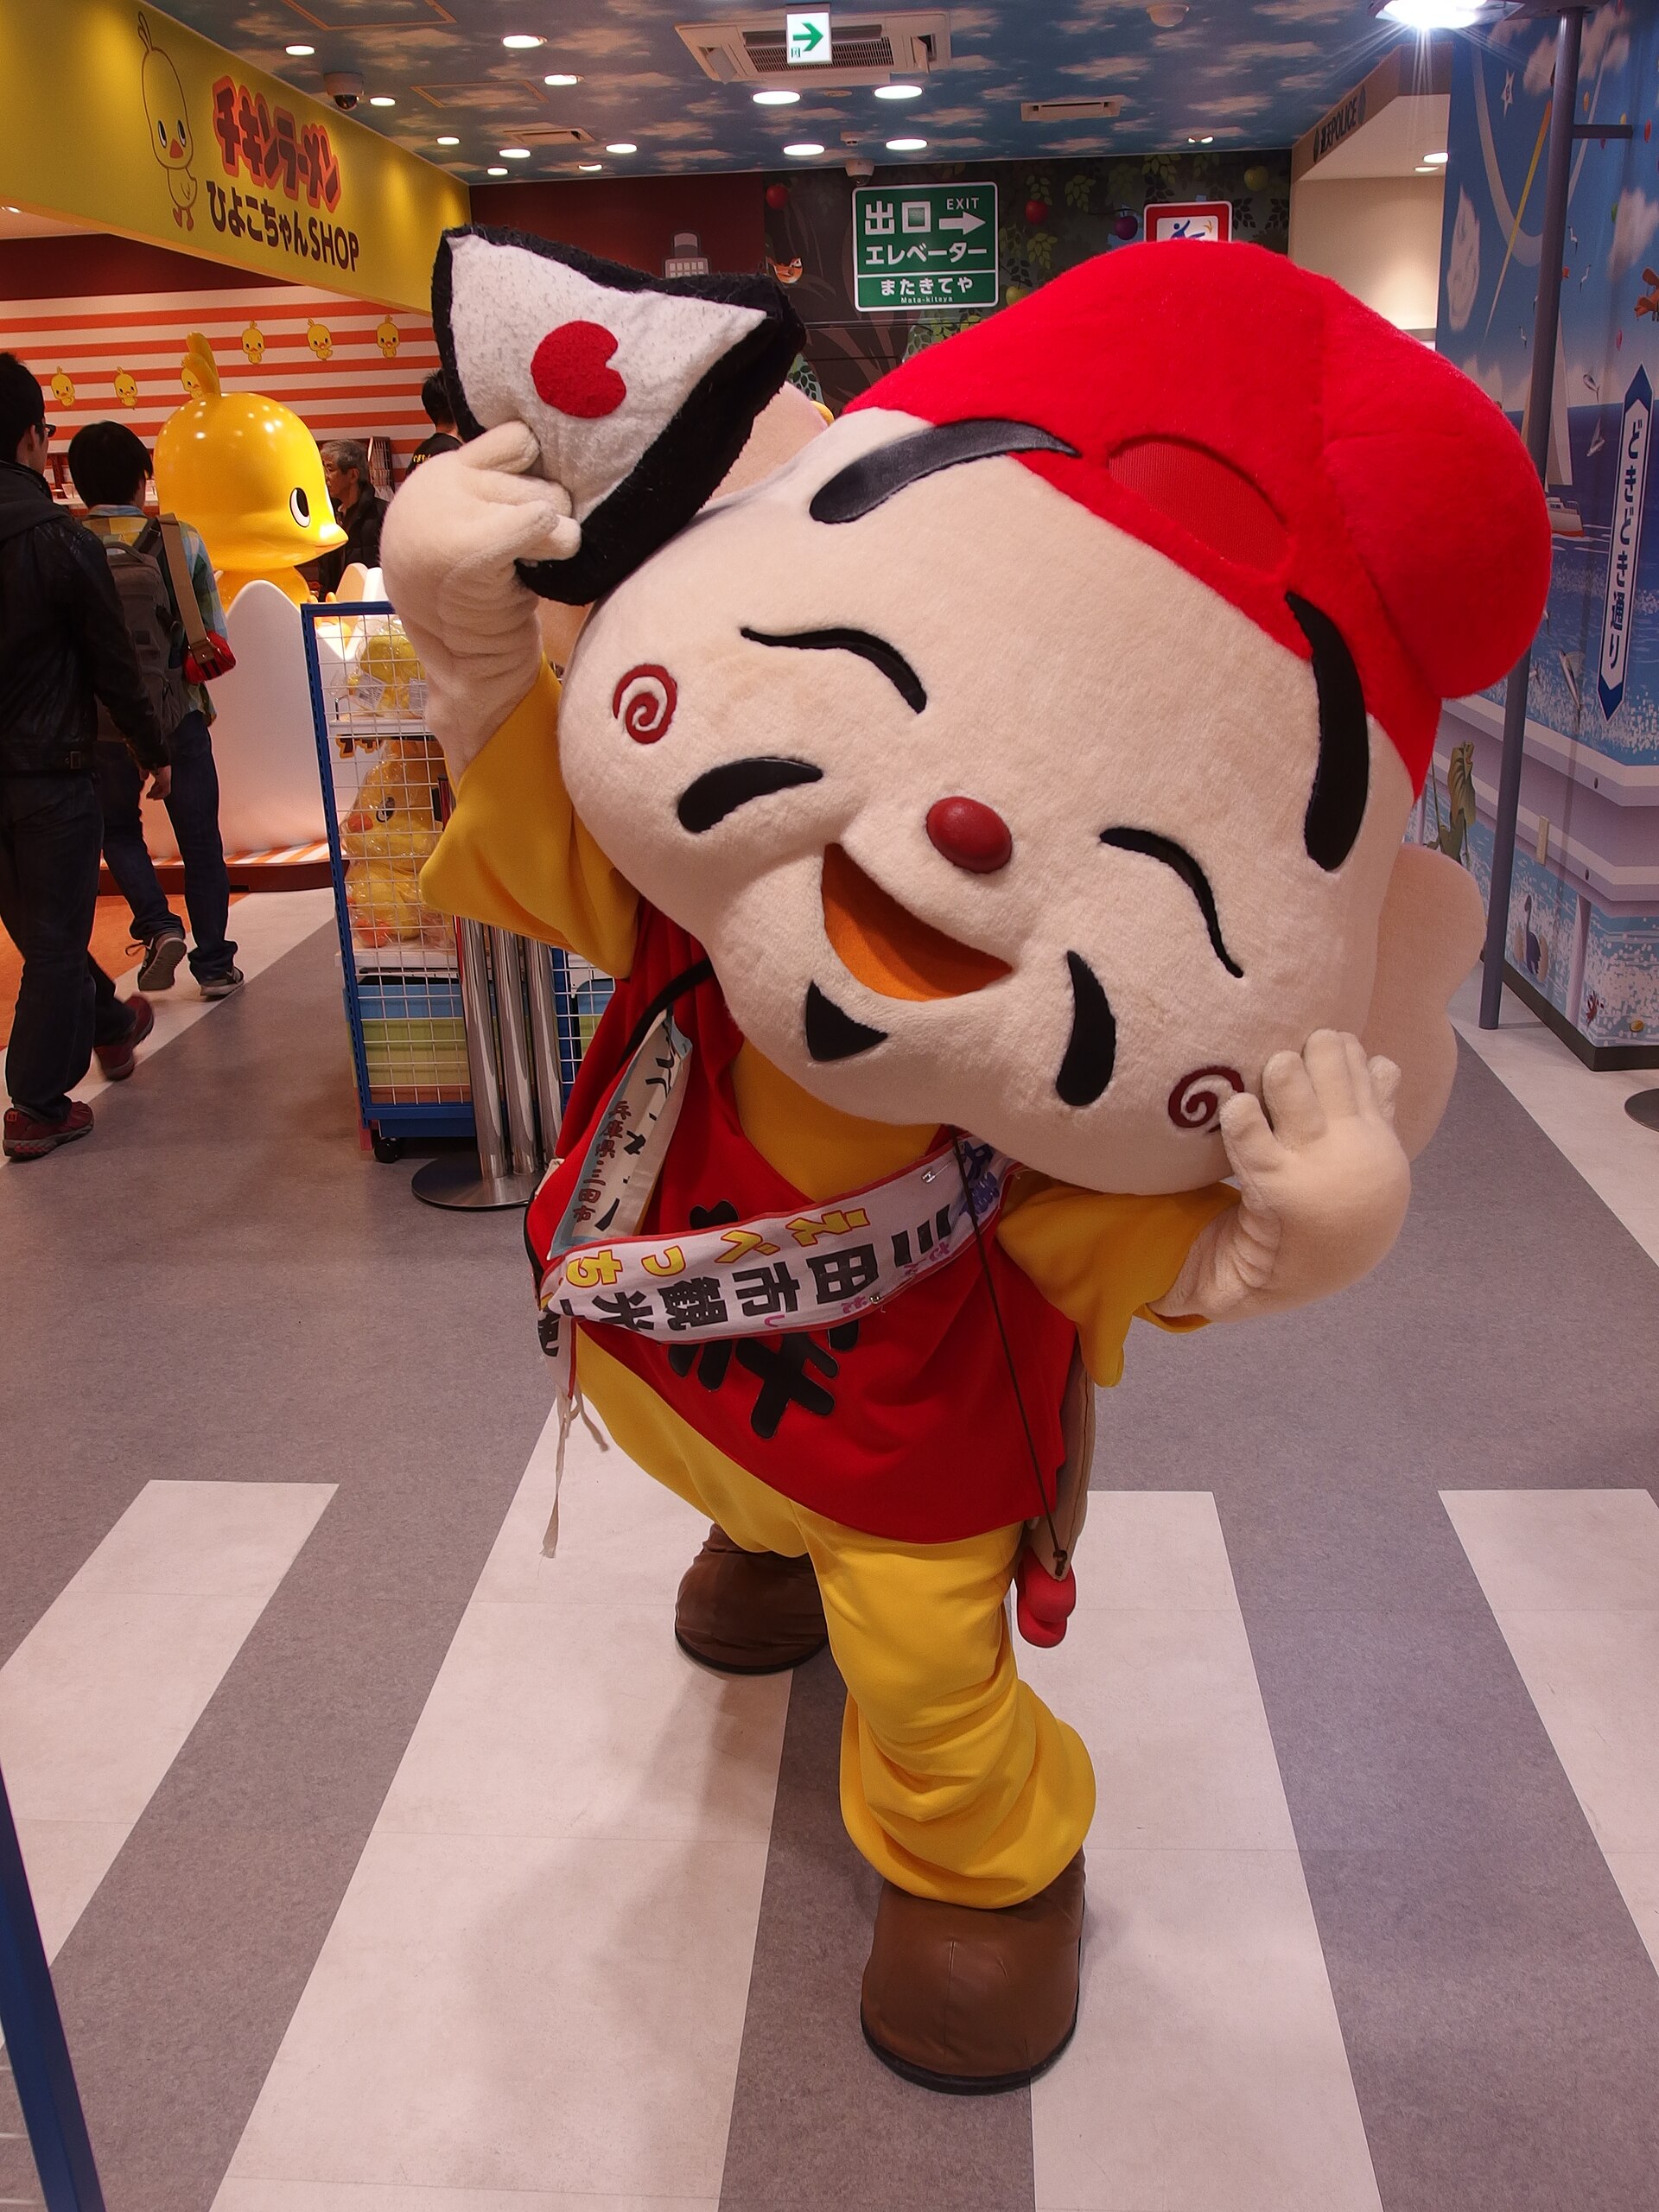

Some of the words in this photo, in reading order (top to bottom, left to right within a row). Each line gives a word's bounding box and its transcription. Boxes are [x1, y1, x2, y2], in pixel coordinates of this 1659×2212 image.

[213, 75, 342, 213] チキンラーメン
[206, 180, 359, 272] ひよこちゃんSHOP
[865, 200, 932, 235] 出口
[946, 197, 979, 210] EXIT
[866, 242, 987, 265] エレベーター
[880, 276, 973, 296] またきてや
[1610, 419, 1642, 670] どきどき通り
[561, 1204, 951, 1332] 三田市観光
